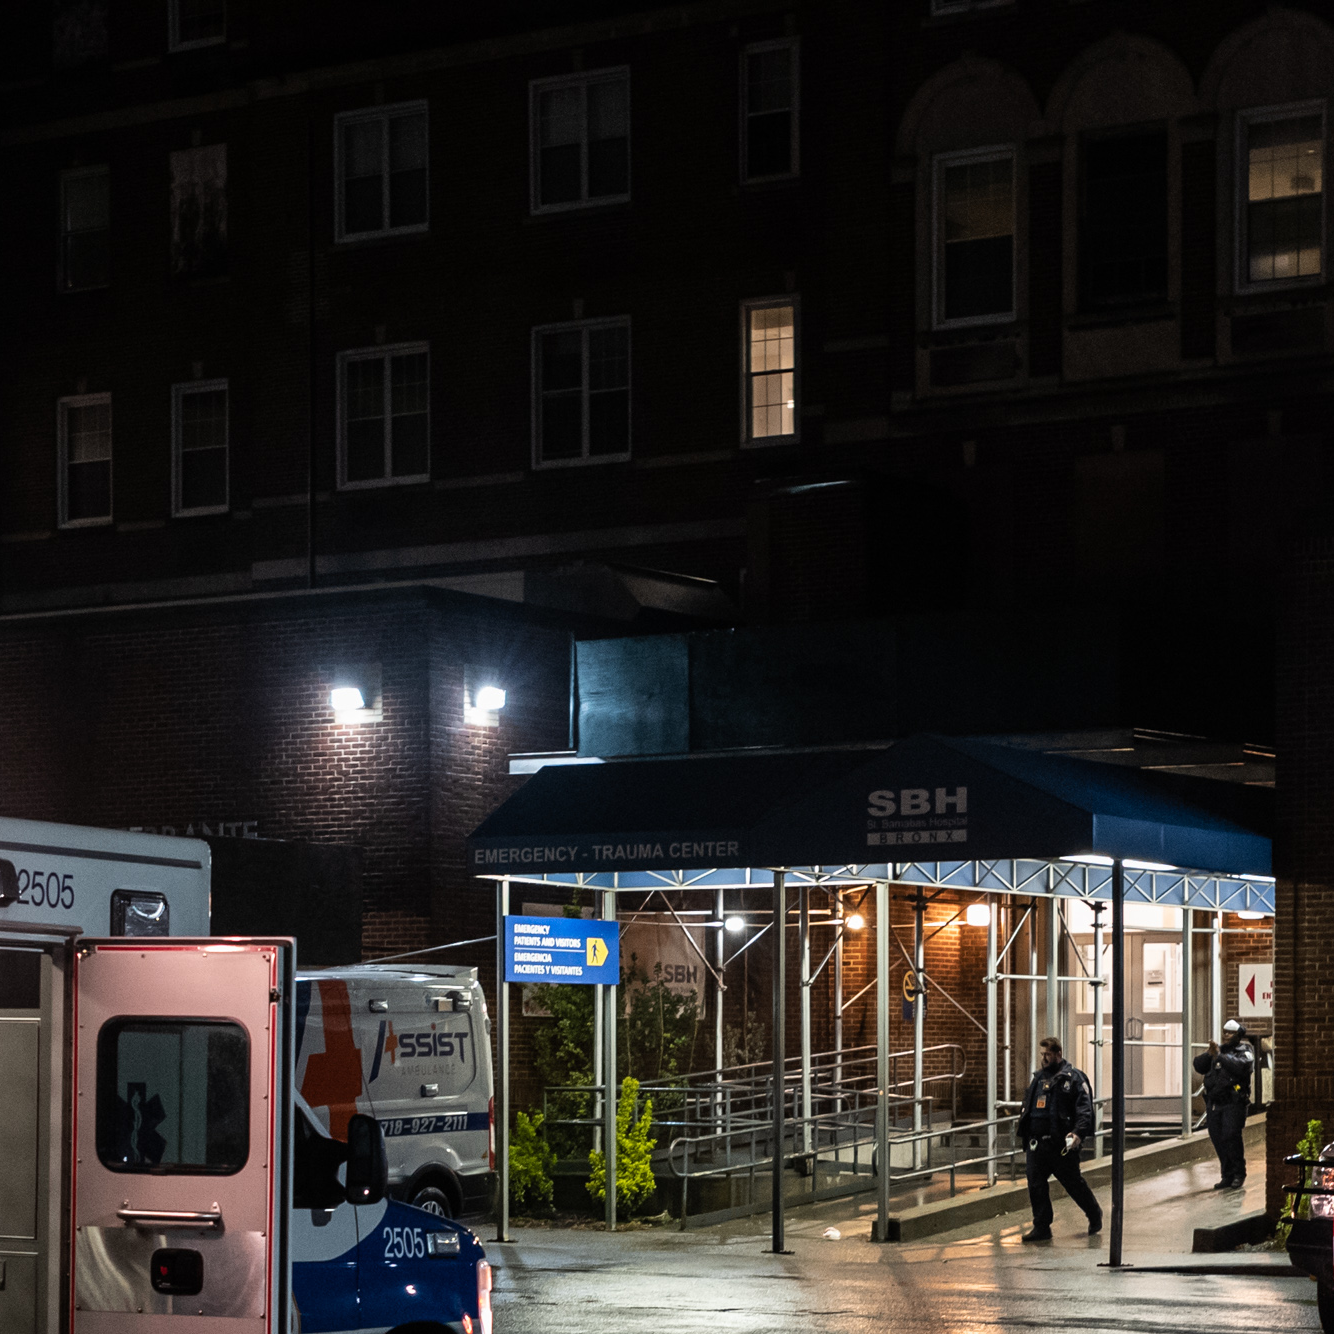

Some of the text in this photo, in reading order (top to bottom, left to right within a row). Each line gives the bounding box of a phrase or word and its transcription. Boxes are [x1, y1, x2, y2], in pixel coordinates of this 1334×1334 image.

[867, 786, 968, 817] SBH
[881, 818, 927, 829] Barnabas
[929, 816, 968, 828] Hospital
[880, 831, 953, 844] BRONX
[475, 846, 578, 865] EMERGENCY
[592, 844, 664, 860] TRAUMA
[669, 841, 740, 858] CENTER
[16, 869, 74, 909] 2505
[513, 923, 551, 935] EMERGENCY
[513, 936, 581, 949] PATIENTS AND VISITORS
[513, 952, 553, 963] EMERGENCIA
[513, 964, 584, 977] PACIENTES Y VISITANTES
[664, 964, 698, 984] SBH
[383, 1226, 425, 1258] 2505
